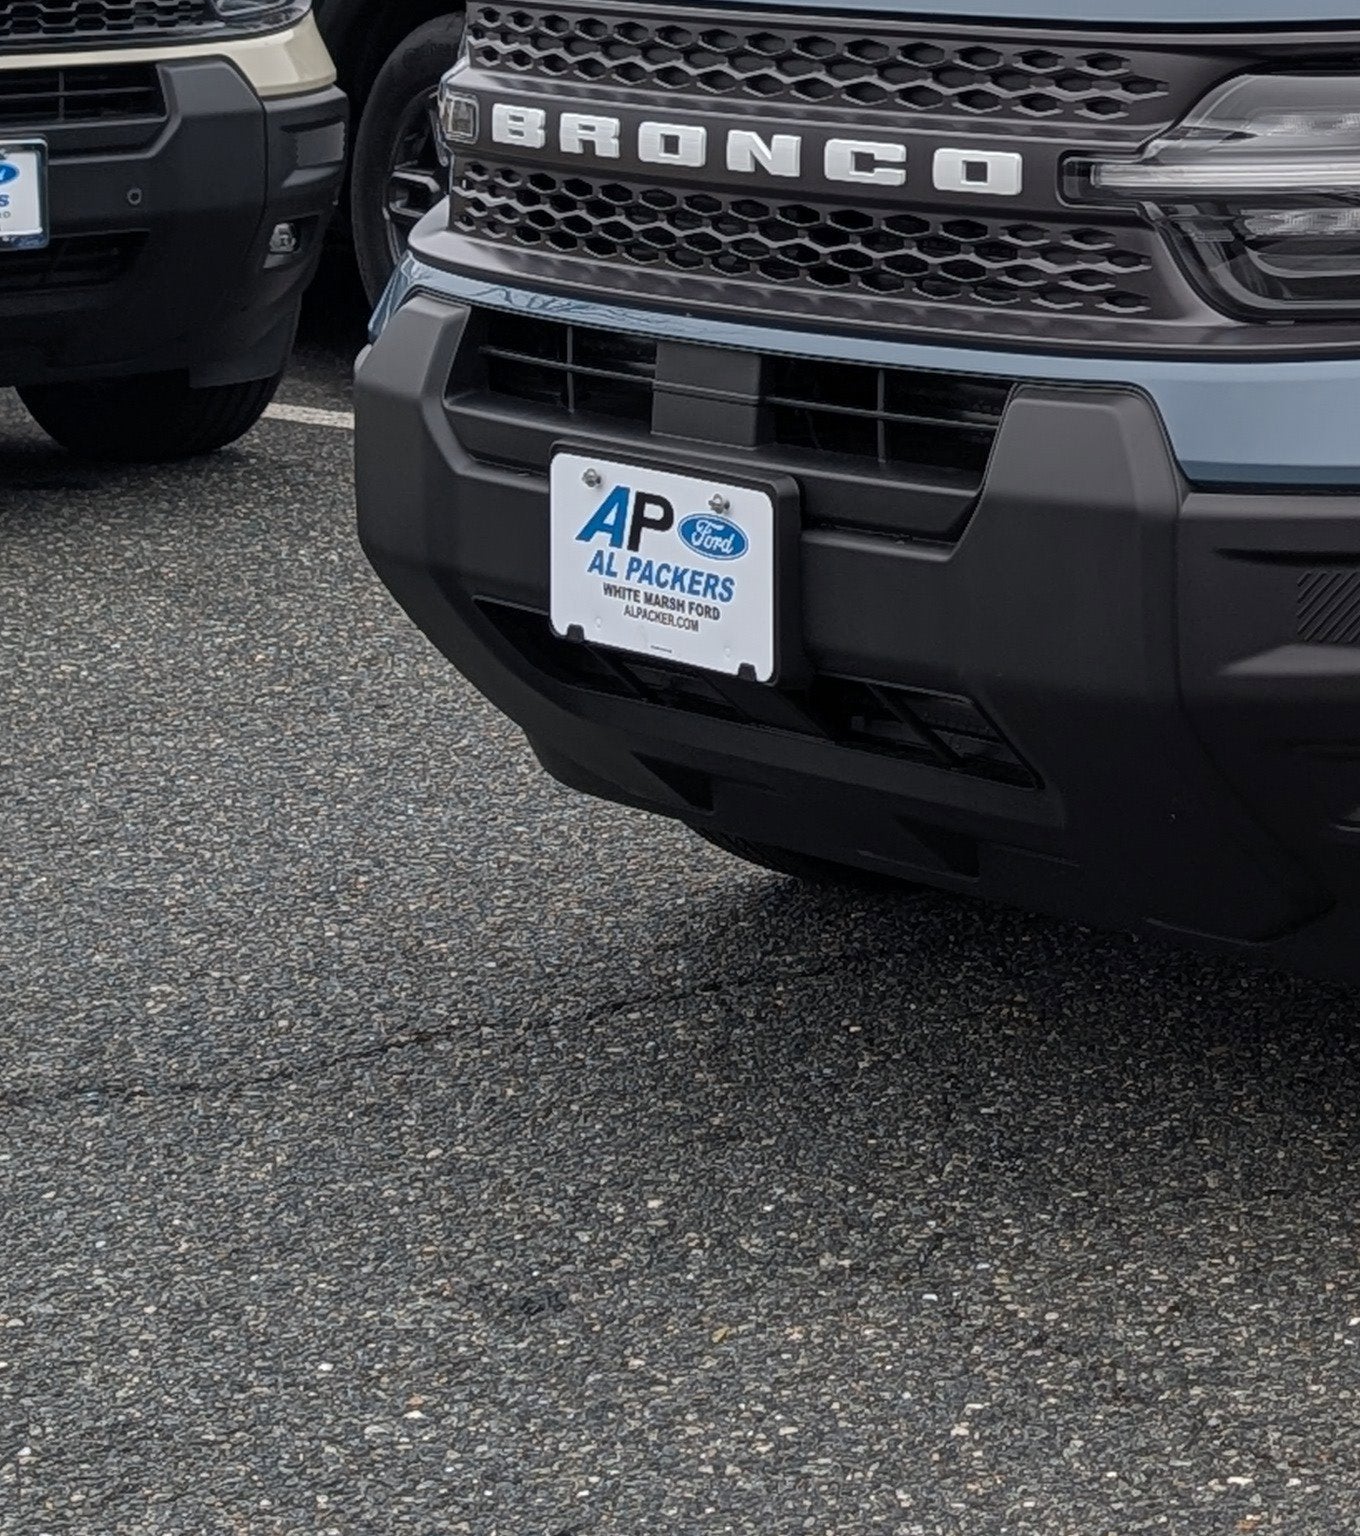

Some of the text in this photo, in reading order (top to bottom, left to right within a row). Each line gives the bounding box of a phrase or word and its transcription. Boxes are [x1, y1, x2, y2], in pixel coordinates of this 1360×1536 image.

[491, 102, 1023, 196] BRONCO
[575, 484, 734, 555] AP Ford
[587, 549, 736, 603] AL PACKERS
[602, 582, 722, 621] WHITE MARSH FORD
[623, 604, 700, 632] ALPACKER.COM
